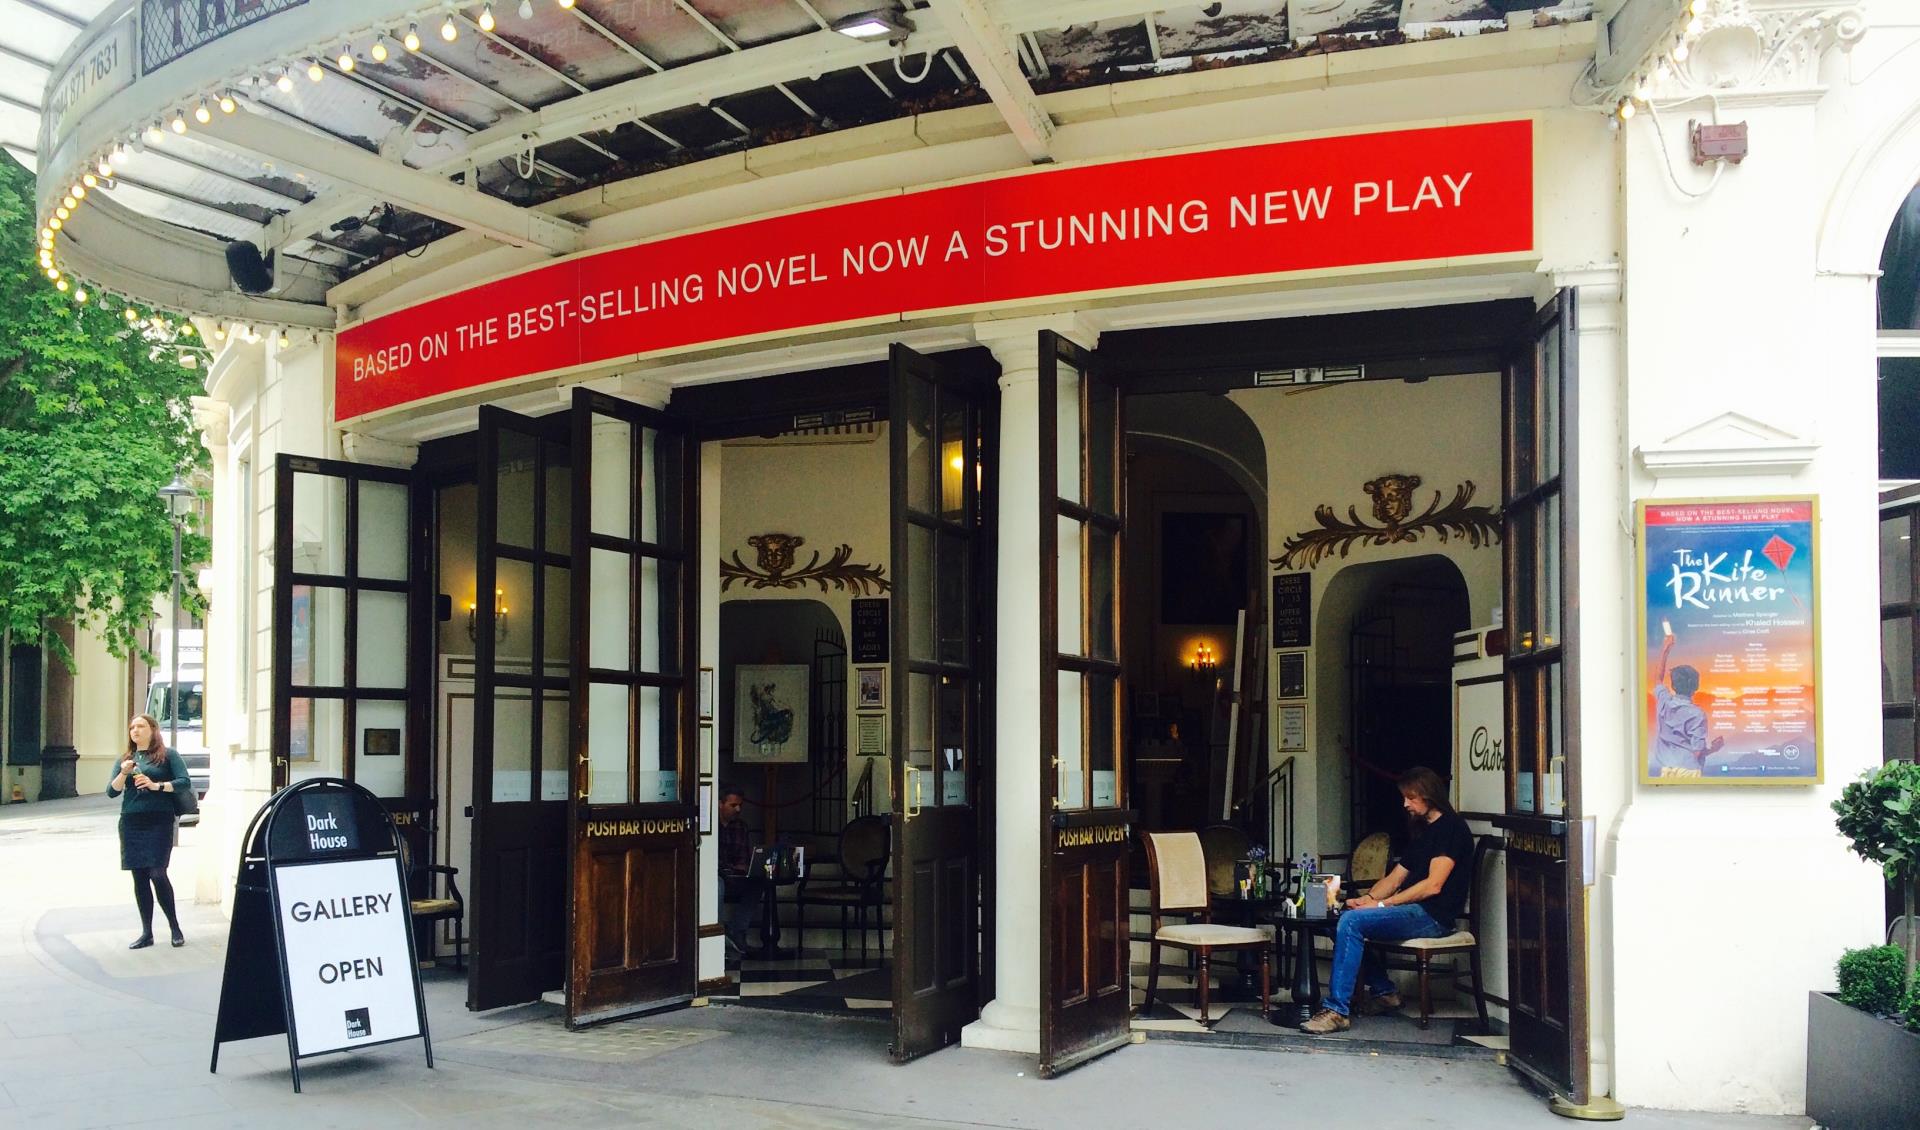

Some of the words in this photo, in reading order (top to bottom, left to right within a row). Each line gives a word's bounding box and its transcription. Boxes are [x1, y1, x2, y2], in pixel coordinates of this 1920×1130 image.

[71, 65, 85, 106] 871
[90, 37, 117, 86] 7631
[354, 343, 411, 381] BASED
[420, 332, 447, 361] ON
[456, 318, 497, 350] THE
[507, 274, 702, 338] BEST-SELLING
[719, 254, 827, 297] NOVEL
[844, 236, 928, 276] NOW
[945, 231, 968, 261] A
[986, 200, 1207, 256] STUNNING
[1231, 186, 1332, 227] NEW
[1355, 173, 1472, 215] PLAY
[1673, 549, 1703, 567] The
[1702, 549, 1767, 586] Kite
[1666, 563, 1784, 609] Runner
[307, 812, 338, 831] Dark
[587, 820, 617, 837] PUSH
[619, 820, 640, 835] BAR
[642, 819, 656, 834] TO
[657, 819, 684, 833] OPEN
[310, 833, 347, 849] House
[1059, 829, 1079, 847] PUSH
[1080, 826, 1094, 845] BAR
[1095, 825, 1104, 843] TO
[1105, 825, 1124, 842] OPEN
[291, 893, 392, 922] GALLERY
[318, 956, 383, 984] OPEN
[346, 1018, 362, 1029] Dark
[348, 1029, 366, 1038] House
